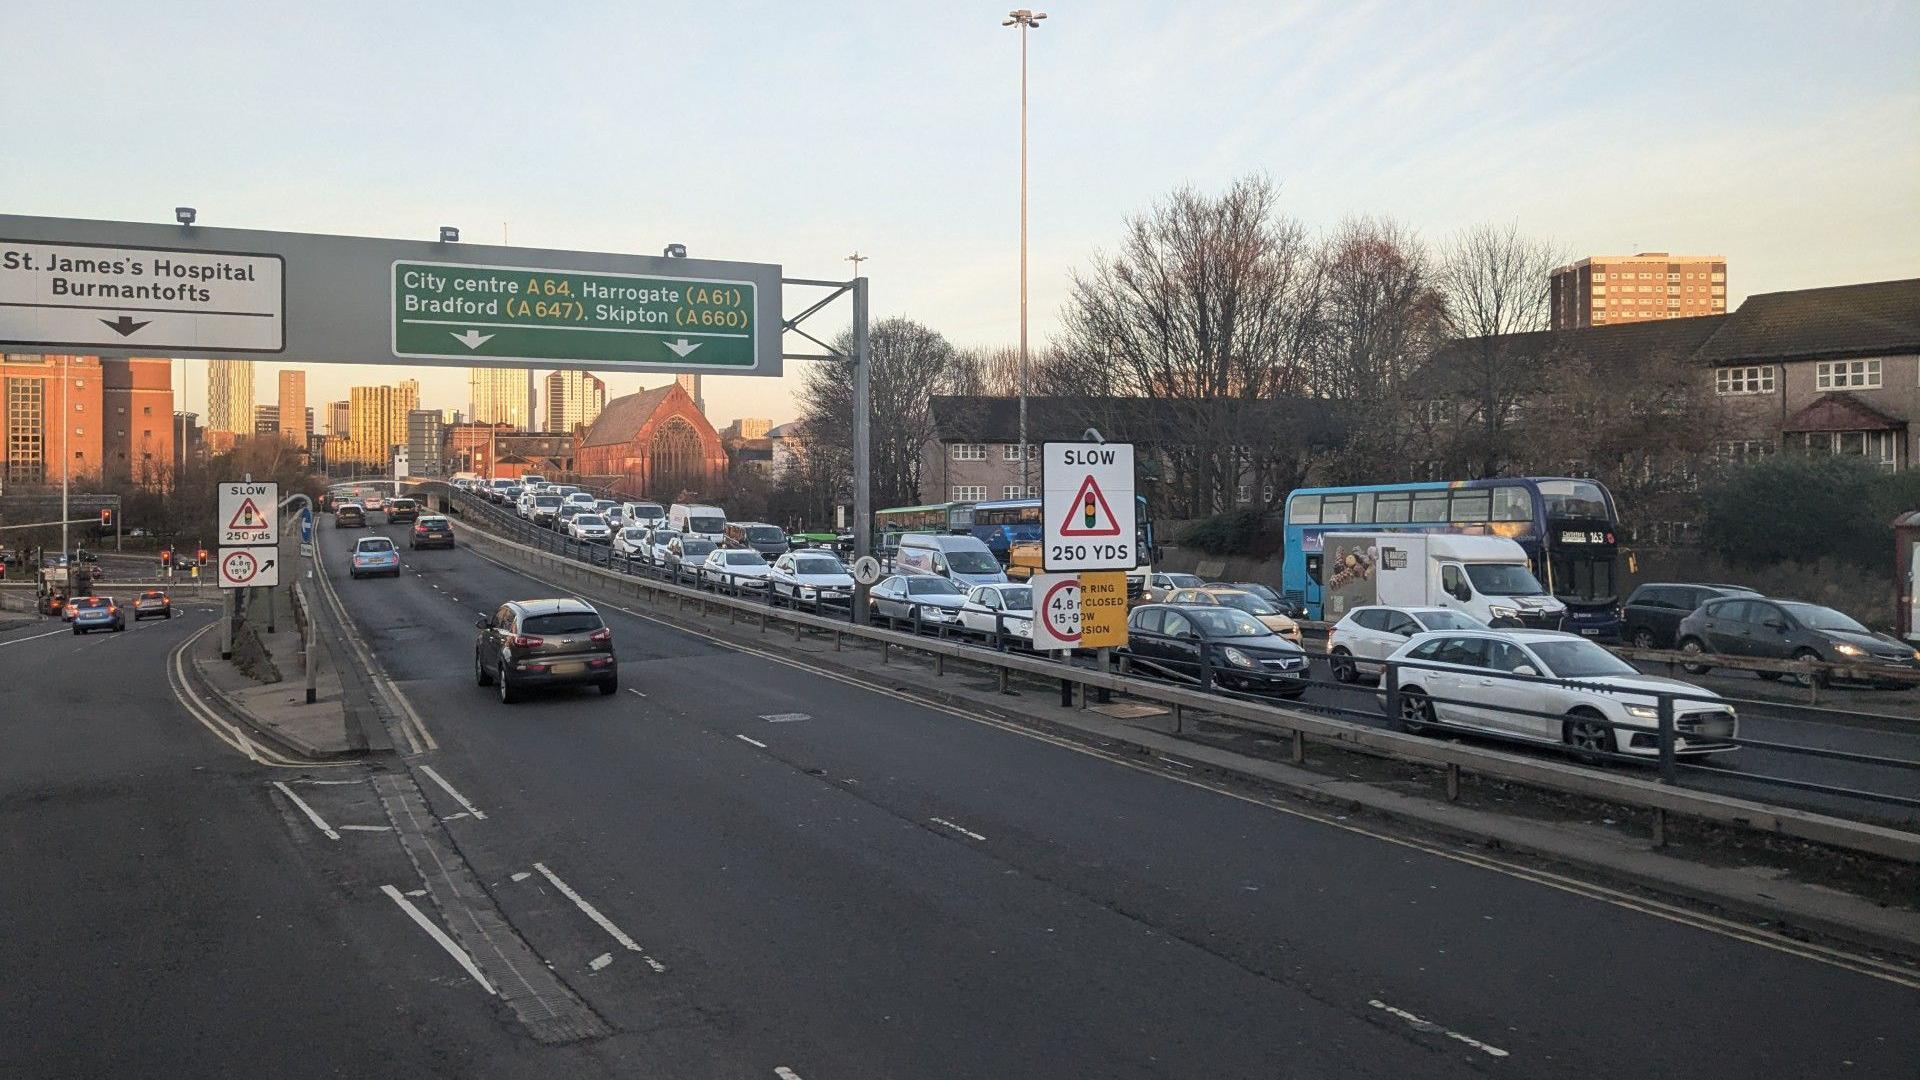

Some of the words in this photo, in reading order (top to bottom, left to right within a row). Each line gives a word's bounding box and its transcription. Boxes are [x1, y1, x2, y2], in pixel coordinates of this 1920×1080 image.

[2, 251, 39, 271] St.
[46, 253, 144, 276] James's
[154, 259, 255, 282] Hospital
[52, 277, 210, 302] Burmantofts
[403, 271, 447, 293] City
[454, 276, 519, 294] centre
[583, 282, 679, 303] Harrogate
[405, 294, 498, 315] Bradford
[596, 304, 668, 324] Skipton
[1064, 450, 1116, 465] SLOW
[230, 486, 266, 495] SLOW
[226, 532, 249, 541] 250
[251, 531, 271, 542] yds
[1590, 531, 1604, 543] 163
[1052, 545, 1087, 561] 250
[1092, 544, 1129, 560] YDS
[1091, 584, 1115, 593] RING
[1085, 598, 1124, 607] CLOSED
